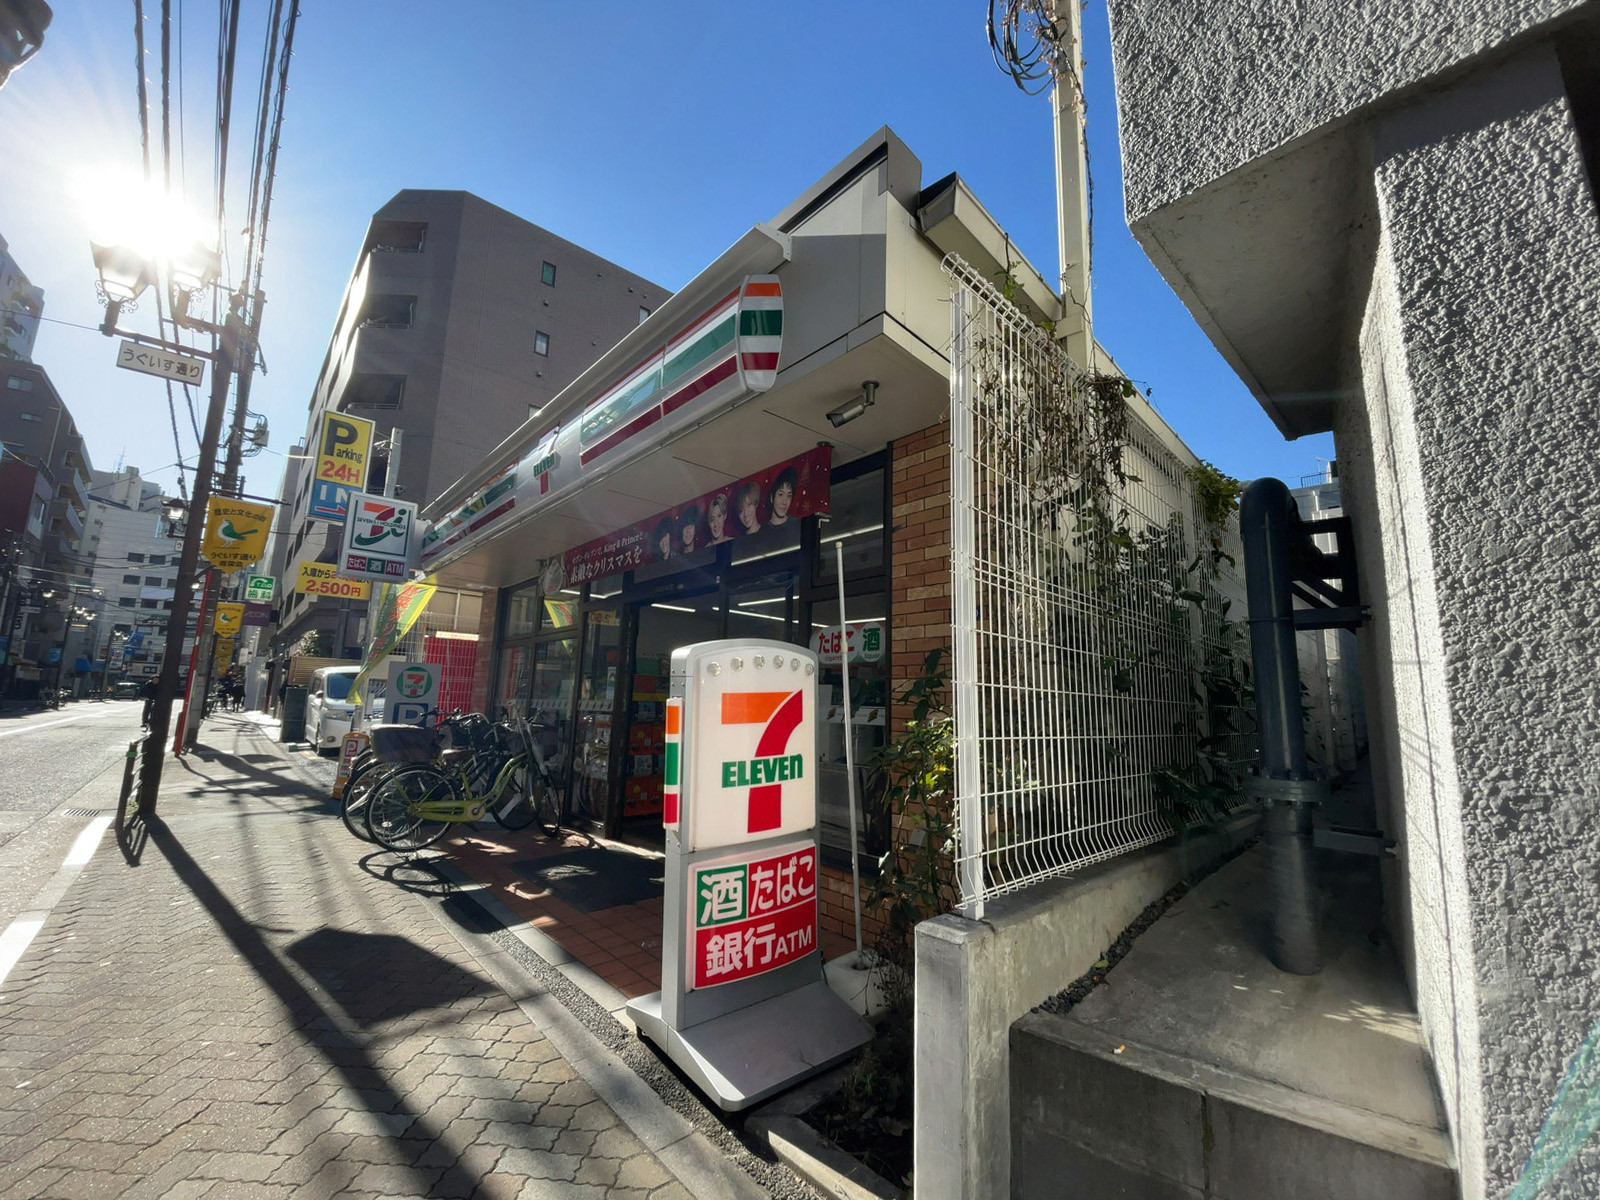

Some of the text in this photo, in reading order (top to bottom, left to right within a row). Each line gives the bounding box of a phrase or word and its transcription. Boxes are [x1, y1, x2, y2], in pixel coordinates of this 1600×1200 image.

[123, 349, 200, 378] うぐいす通り
[321, 460, 360, 484] 24H
[603, 542, 616, 553] King
[387, 563, 404, 575] ATM
[570, 545, 643, 584] 素敵なクリスマスを
[305, 579, 361, 597] 2,500円
[818, 631, 855, 654] たばこ
[863, 627, 881, 651] 酒
[721, 689, 803, 834] 7
[750, 855, 815, 914] たばこ
[701, 871, 745, 925] 酒
